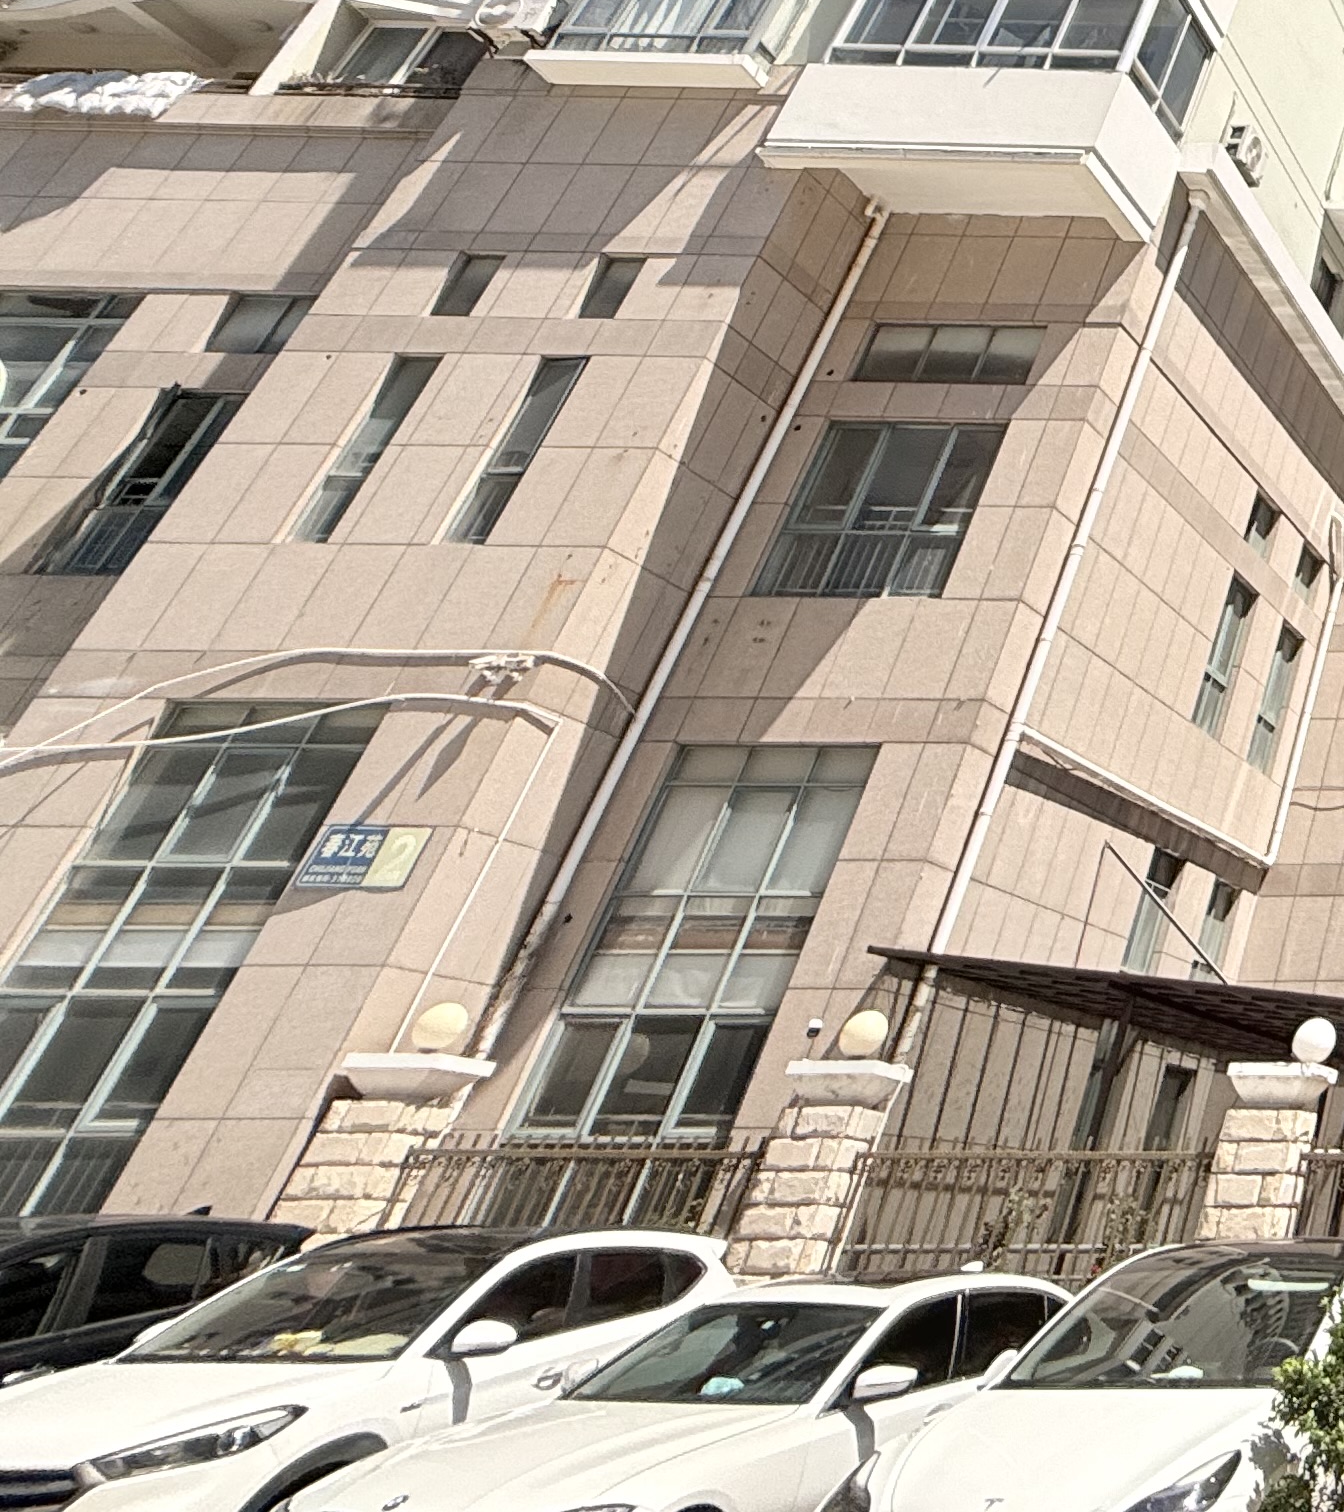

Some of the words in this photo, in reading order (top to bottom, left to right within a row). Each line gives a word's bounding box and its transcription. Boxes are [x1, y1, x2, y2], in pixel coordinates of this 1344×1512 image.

[320, 833, 384, 858] 春江苑
[374, 834, 417, 881] 2
